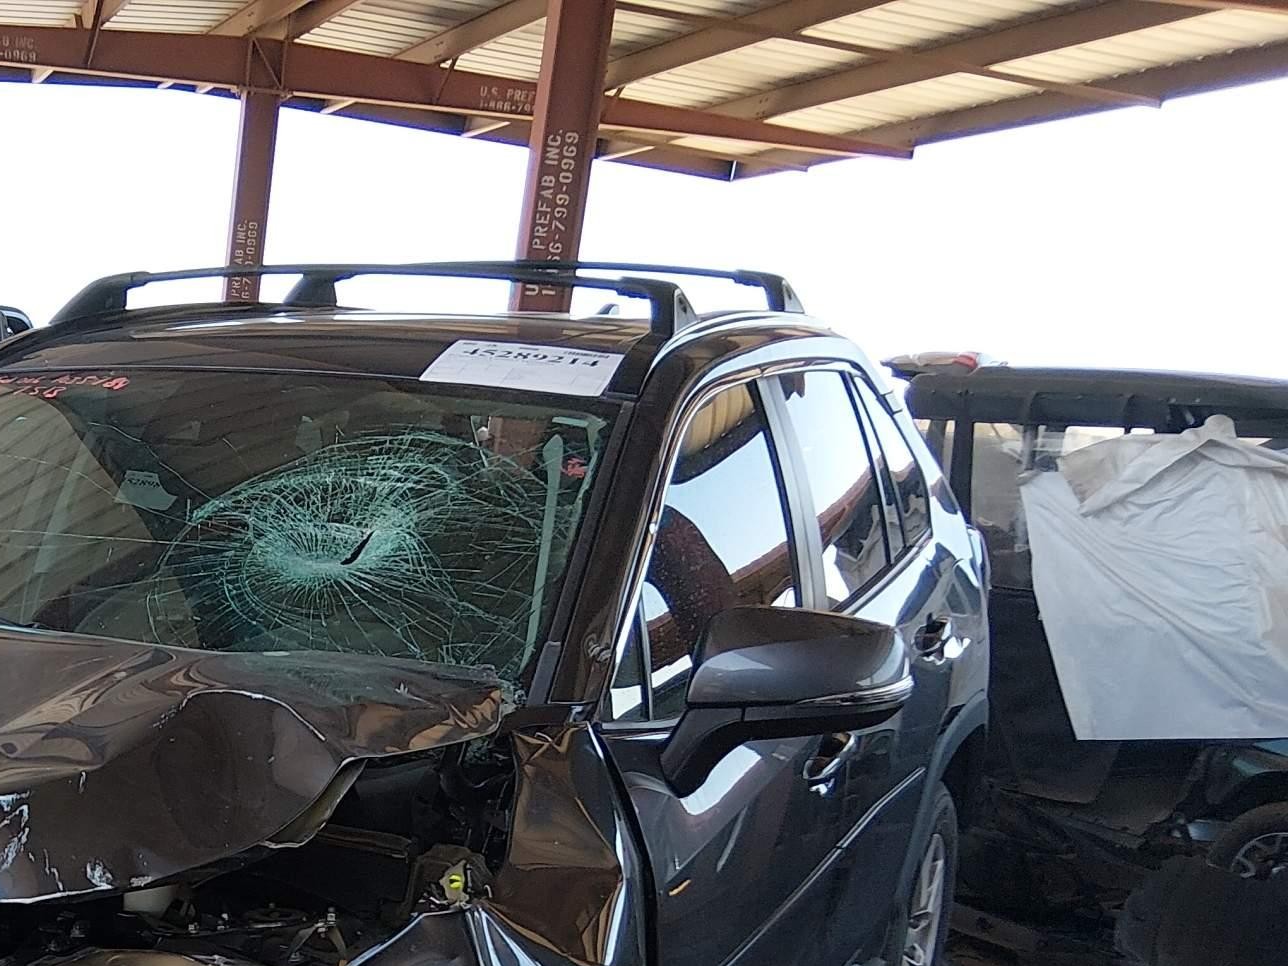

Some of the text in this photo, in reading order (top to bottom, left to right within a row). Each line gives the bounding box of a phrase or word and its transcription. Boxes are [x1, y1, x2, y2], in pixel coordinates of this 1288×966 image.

[506, 88, 536, 103] PREF
[479, 99, 532, 113] 1-866-79
[532, 175, 556, 250] PREFAB
[544, 129, 563, 165] INC.
[232, 219, 248, 297] PRAB INC.
[463, 347, 600, 367] 45289214
